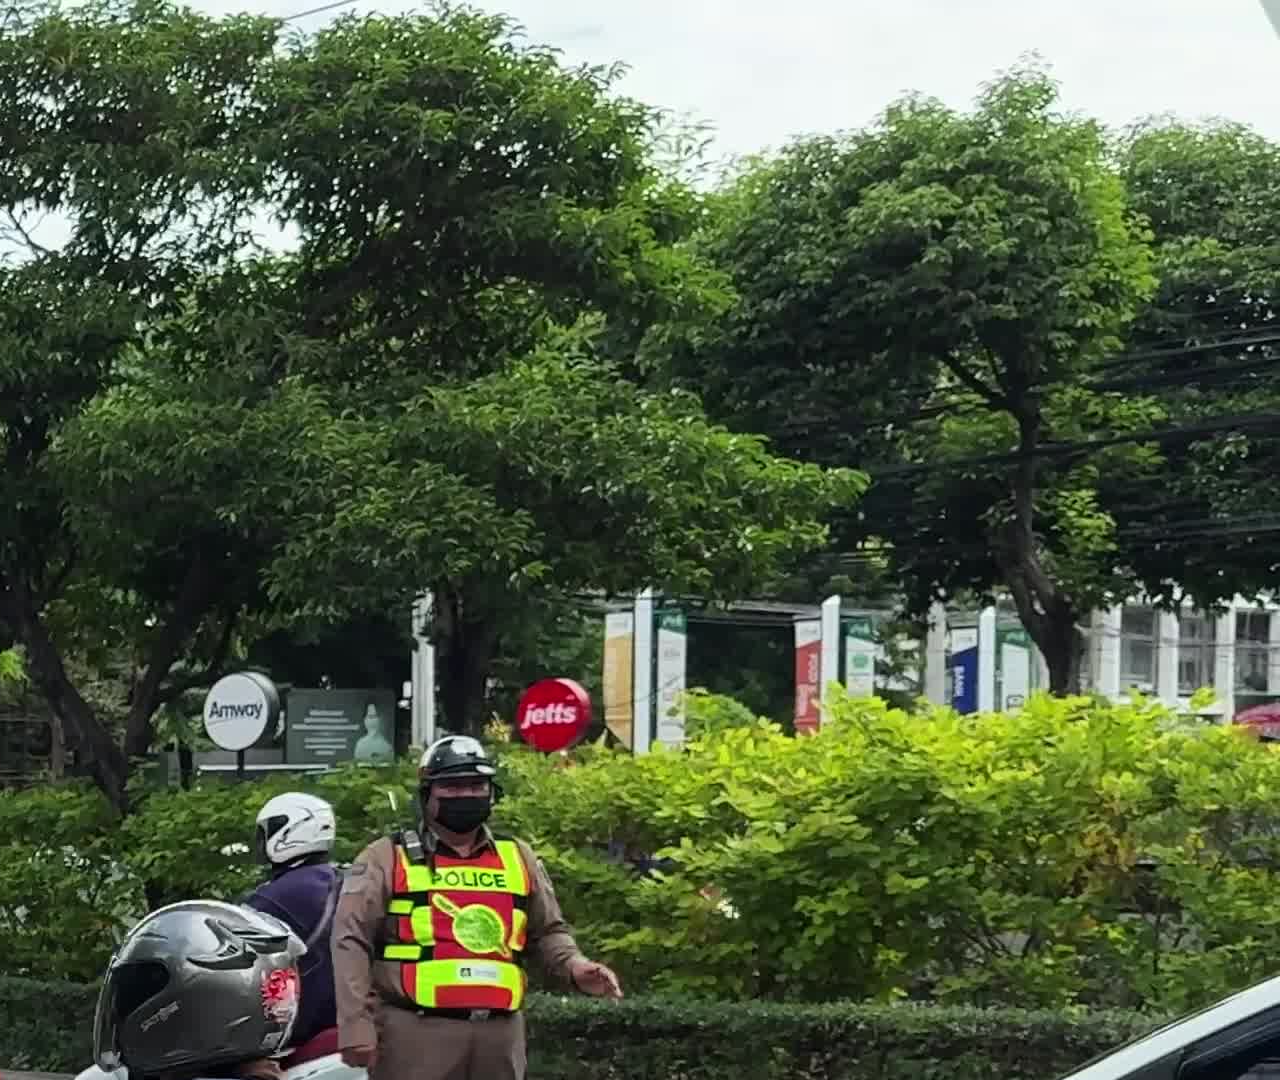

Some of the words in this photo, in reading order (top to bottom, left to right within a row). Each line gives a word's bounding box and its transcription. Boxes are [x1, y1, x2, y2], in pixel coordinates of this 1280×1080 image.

[208, 701, 263, 719] Amway
[520, 702, 577, 729] jetts
[431, 870, 507, 888] POLICE
